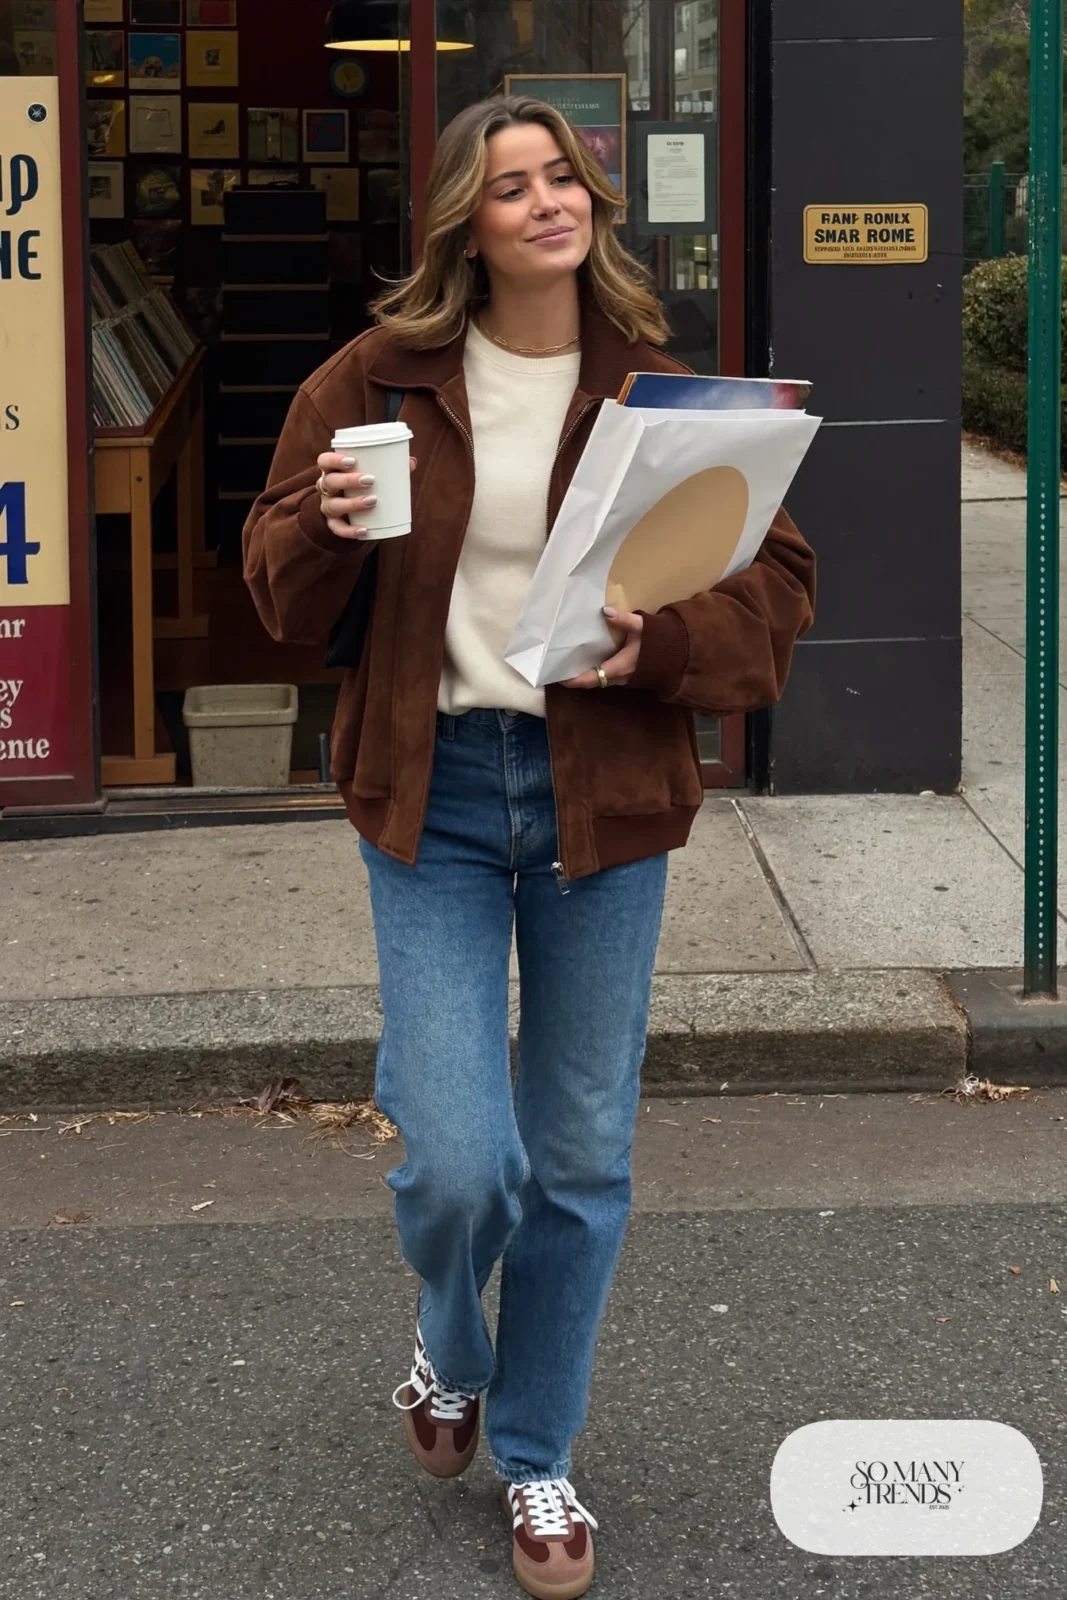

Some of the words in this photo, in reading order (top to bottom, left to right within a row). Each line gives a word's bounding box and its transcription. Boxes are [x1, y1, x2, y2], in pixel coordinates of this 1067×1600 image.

[814, 228, 861, 243] SMAR
[867, 228, 915, 243] ROME
[0, 481, 41, 585] 4
